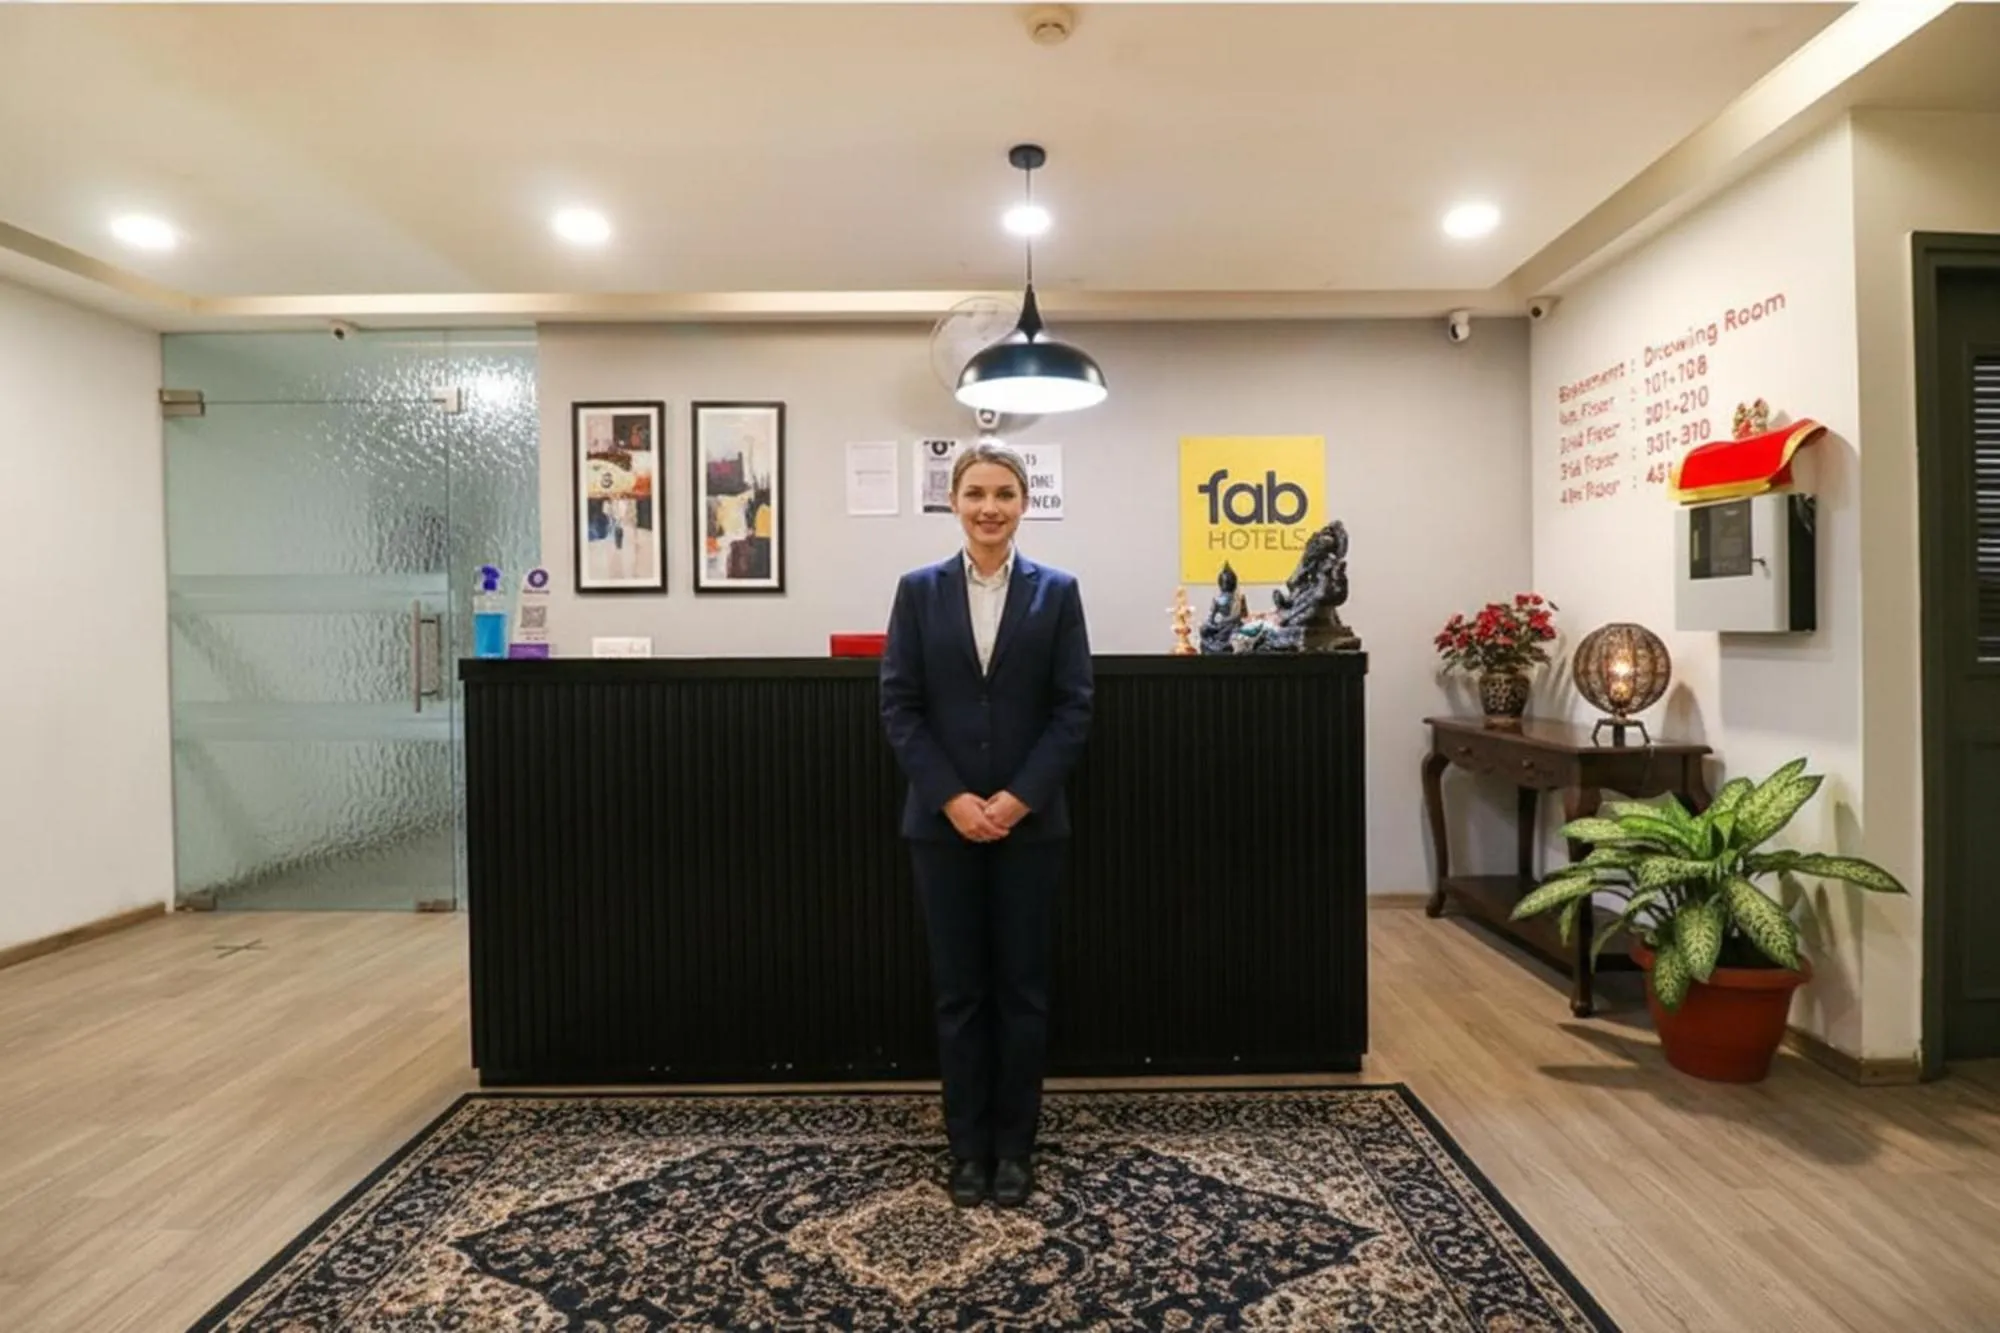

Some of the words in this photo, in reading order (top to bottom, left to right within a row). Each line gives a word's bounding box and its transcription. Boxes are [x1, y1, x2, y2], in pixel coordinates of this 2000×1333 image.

[1724, 293, 1786, 332] Room
[1198, 469, 1308, 525] fab
[1208, 529, 1307, 551] HOTELS
